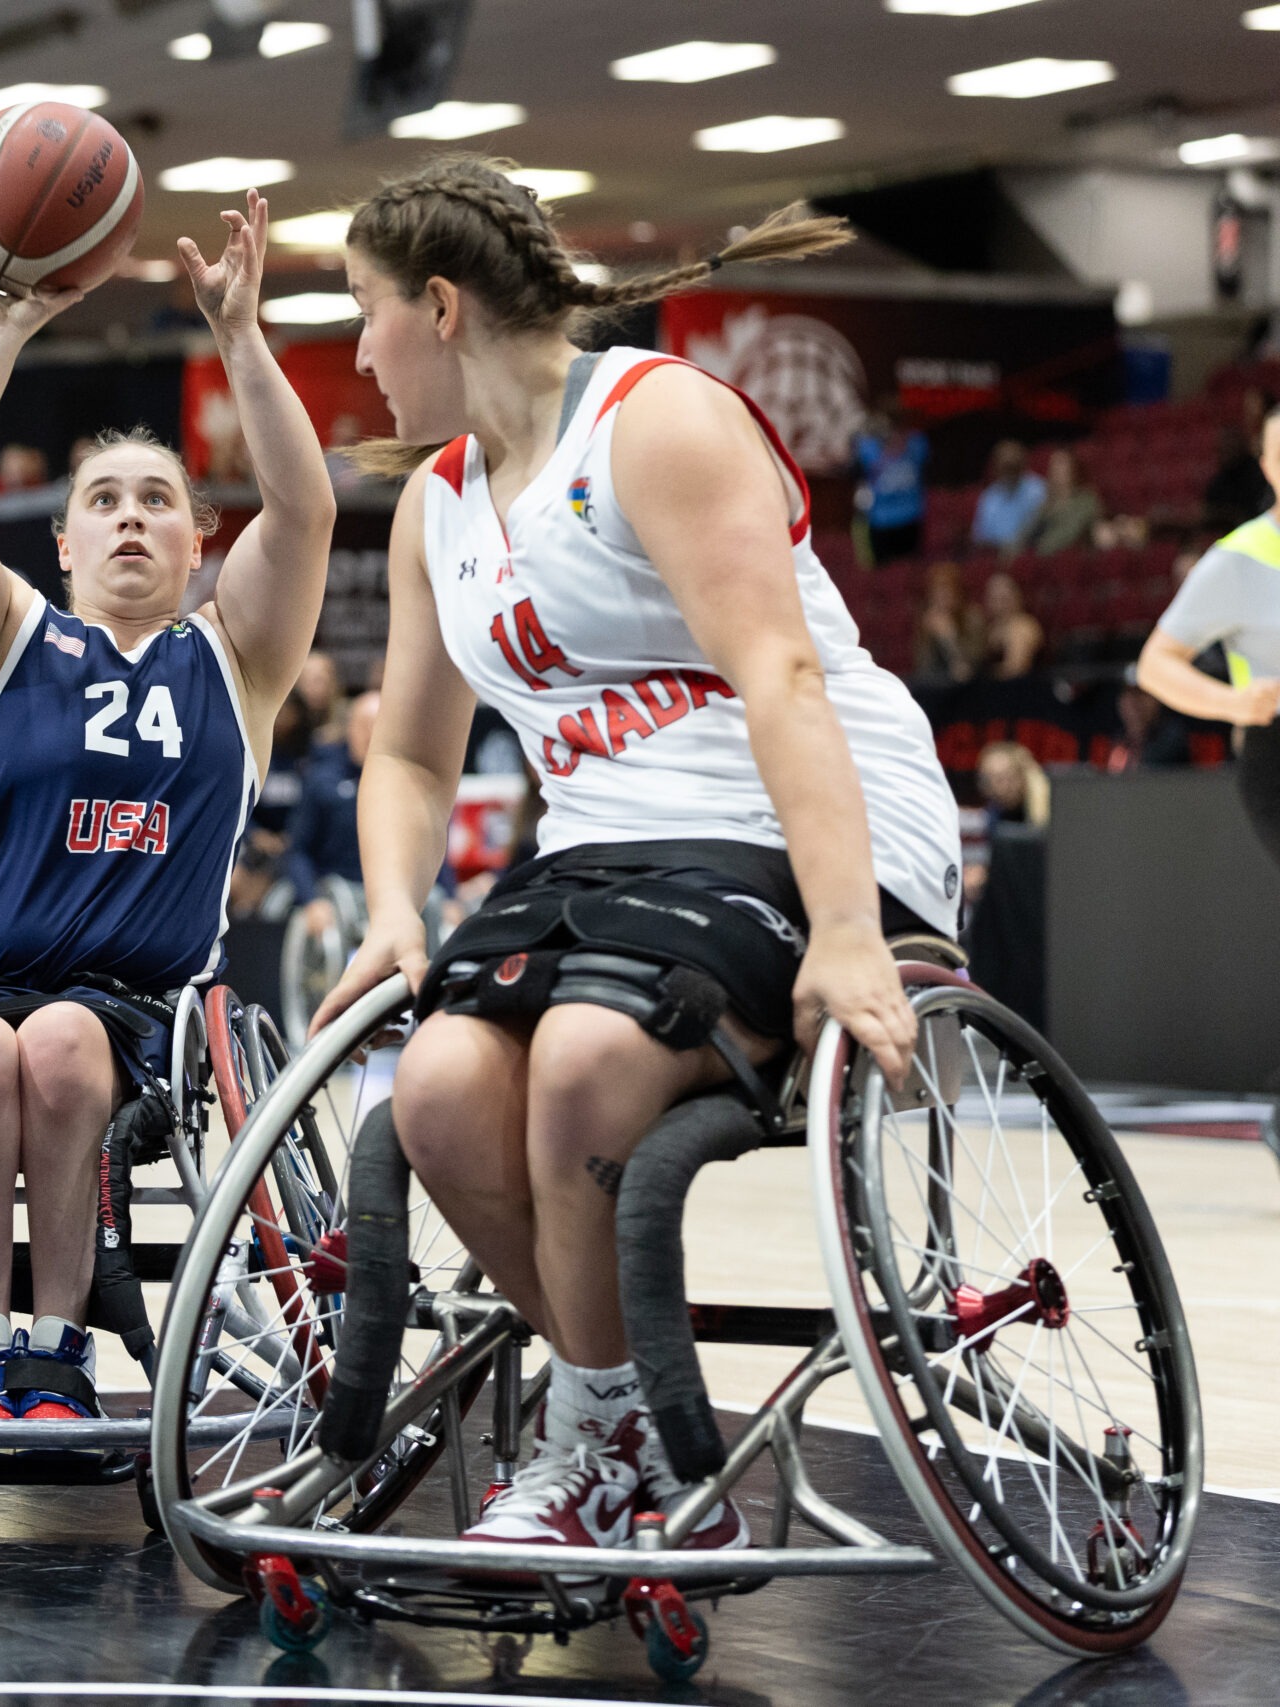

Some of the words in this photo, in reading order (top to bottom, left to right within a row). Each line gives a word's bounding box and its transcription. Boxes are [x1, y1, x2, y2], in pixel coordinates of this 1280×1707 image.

[66, 139, 113, 208] molten
[490, 597, 584, 691] 14
[84, 680, 183, 758] 24
[66, 799, 170, 855] USA
